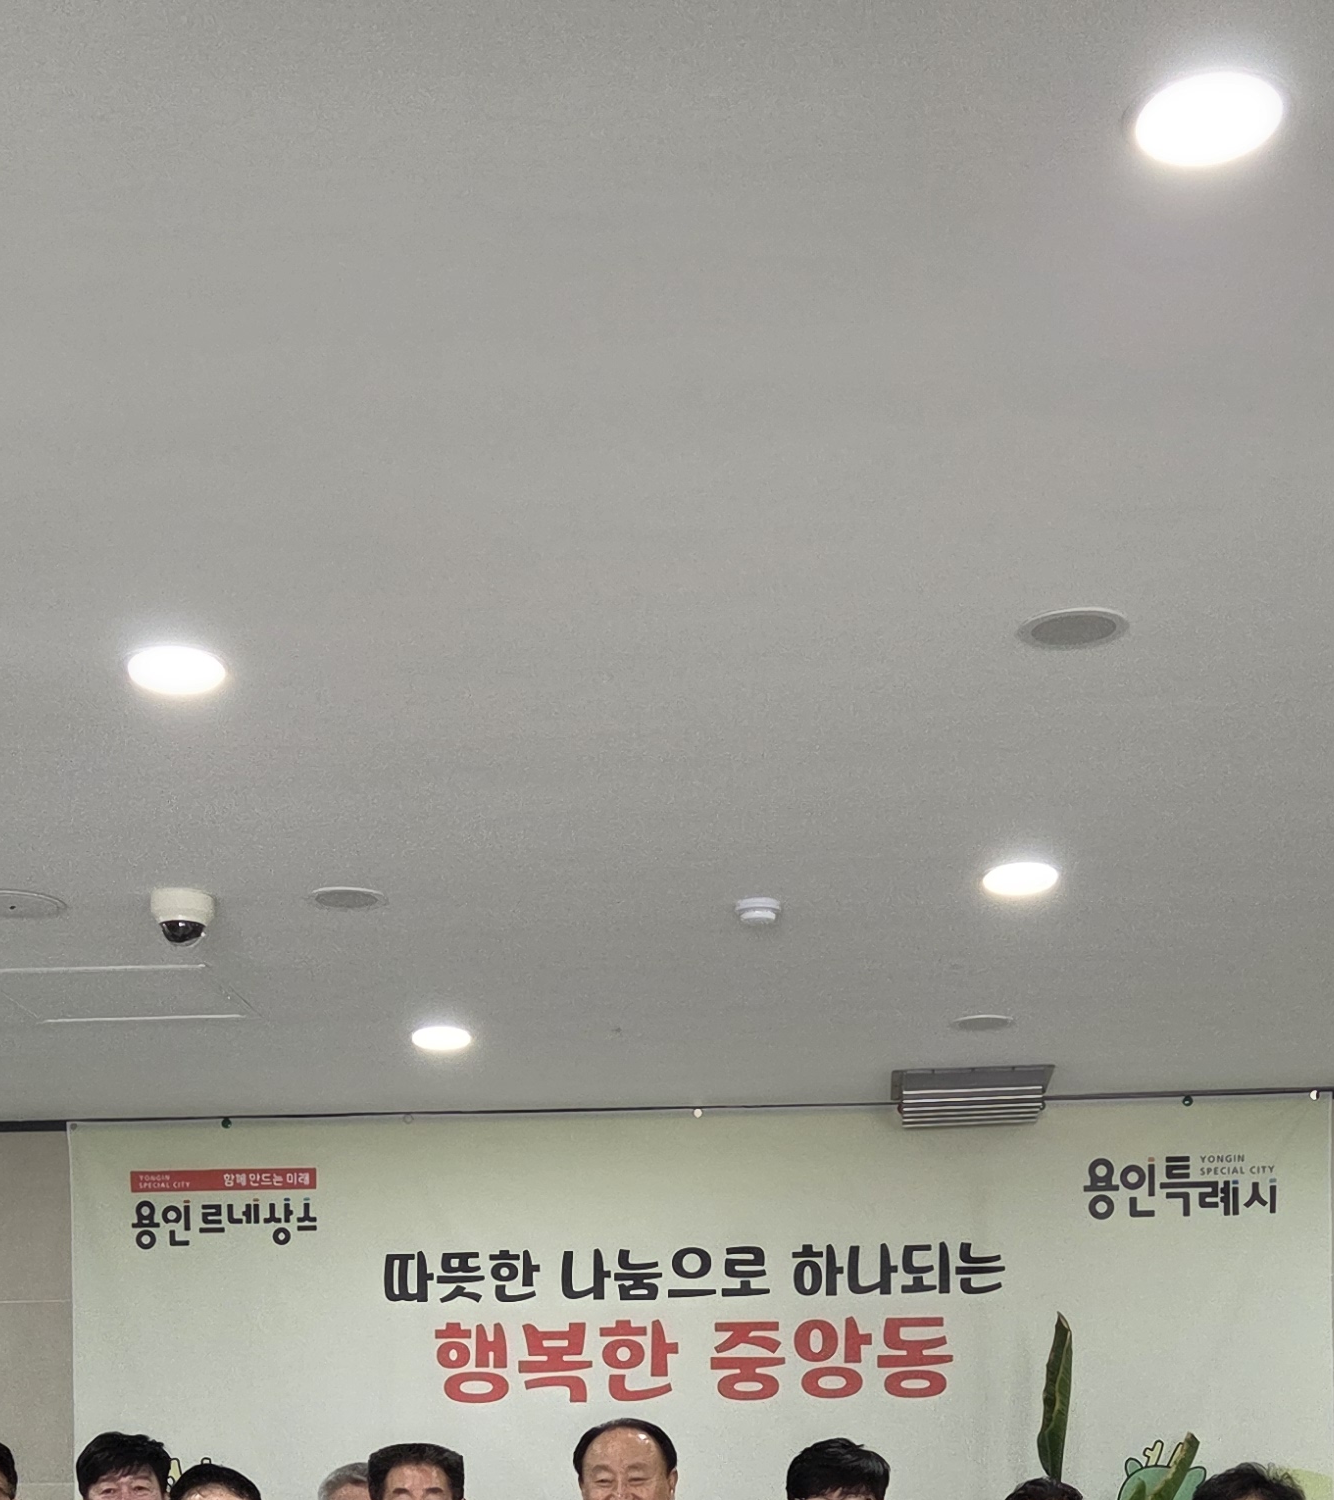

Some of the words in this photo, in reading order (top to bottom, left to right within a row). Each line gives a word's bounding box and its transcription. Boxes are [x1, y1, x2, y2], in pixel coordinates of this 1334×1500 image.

[1200, 1154, 1245, 1163] YONGIN
[1200, 1166, 1245, 1176] SPECIAL
[1249, 1165, 1275, 1175] CITY
[139, 1174, 170, 1182] YONGIN
[223, 1173, 247, 1187] 함께
[249, 1173, 283, 1187] 만드는
[286, 1172, 310, 1186] 미래
[1083, 1156, 1277, 1220] 용인특례시
[131, 1199, 191, 1250] 용인
[199, 1197, 317, 1246] 르네상스
[384, 1250, 540, 1304] 따뜻한
[561, 1246, 770, 1303] 나눔으로
[792, 1241, 1006, 1297] 하나되는
[435, 1319, 679, 1404] 행복한
[709, 1315, 954, 1402] 중앙동
